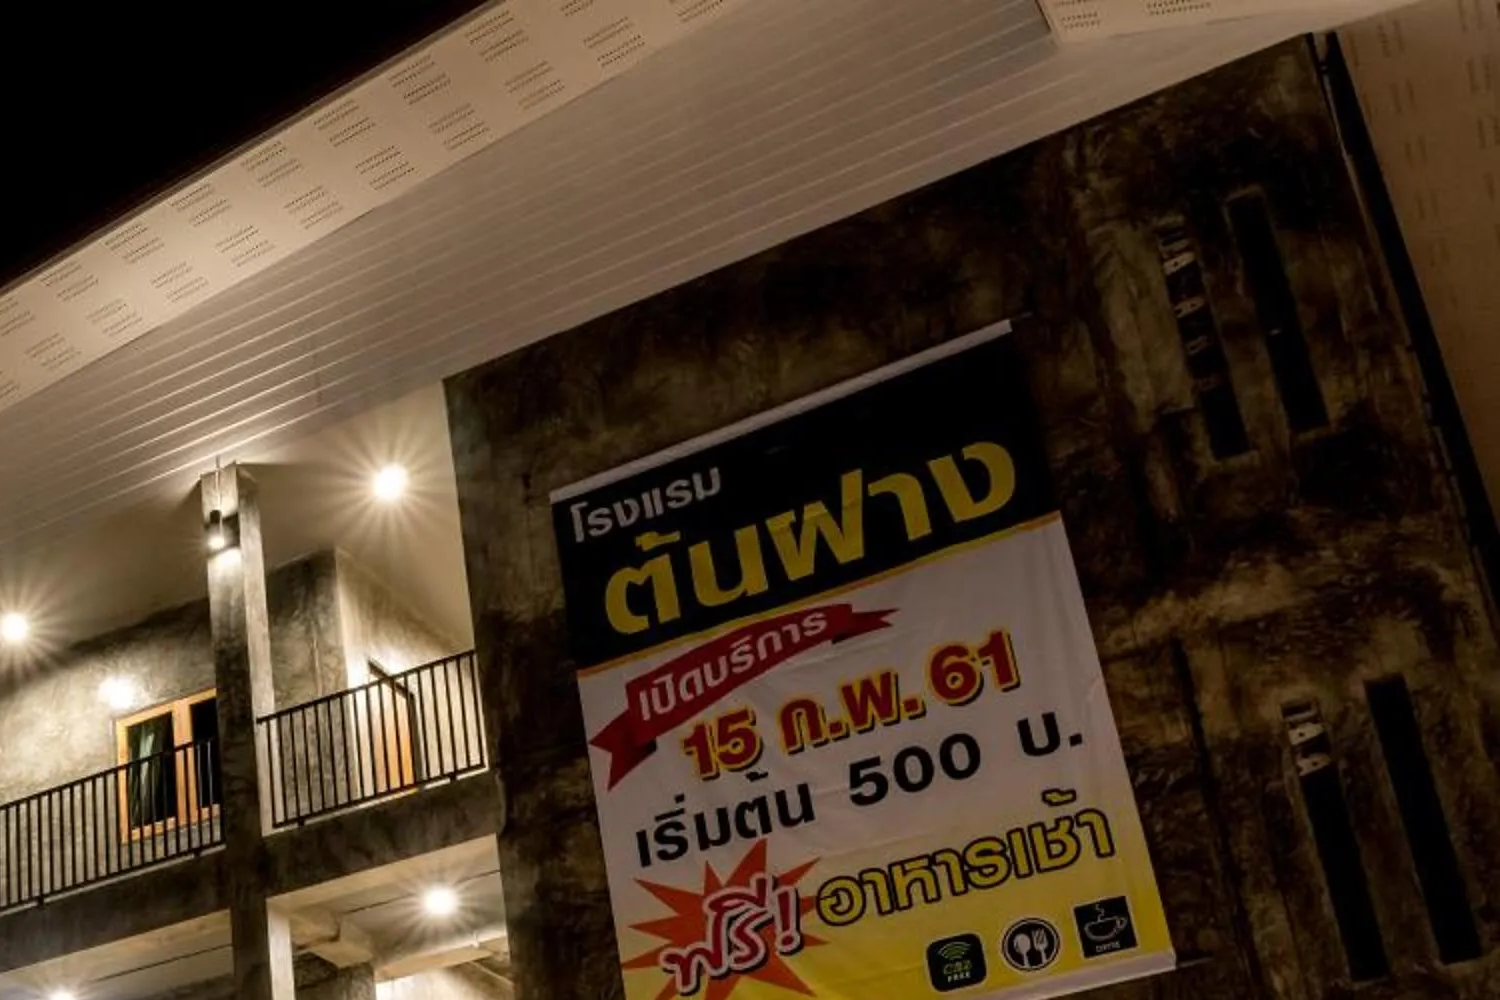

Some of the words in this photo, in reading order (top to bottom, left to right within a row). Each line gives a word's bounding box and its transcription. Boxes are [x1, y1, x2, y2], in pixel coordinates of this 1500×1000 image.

[568, 465, 724, 545] โรงแรม
[636, 609, 829, 723] เปิดบริการ
[636, 770, 816, 867] เริ่มต้น
[848, 732, 982, 807] 500
[1017, 712, 1083, 757] บ.
[682, 707, 764, 782] 15
[816, 788, 1115, 927] อาหารเช้า
